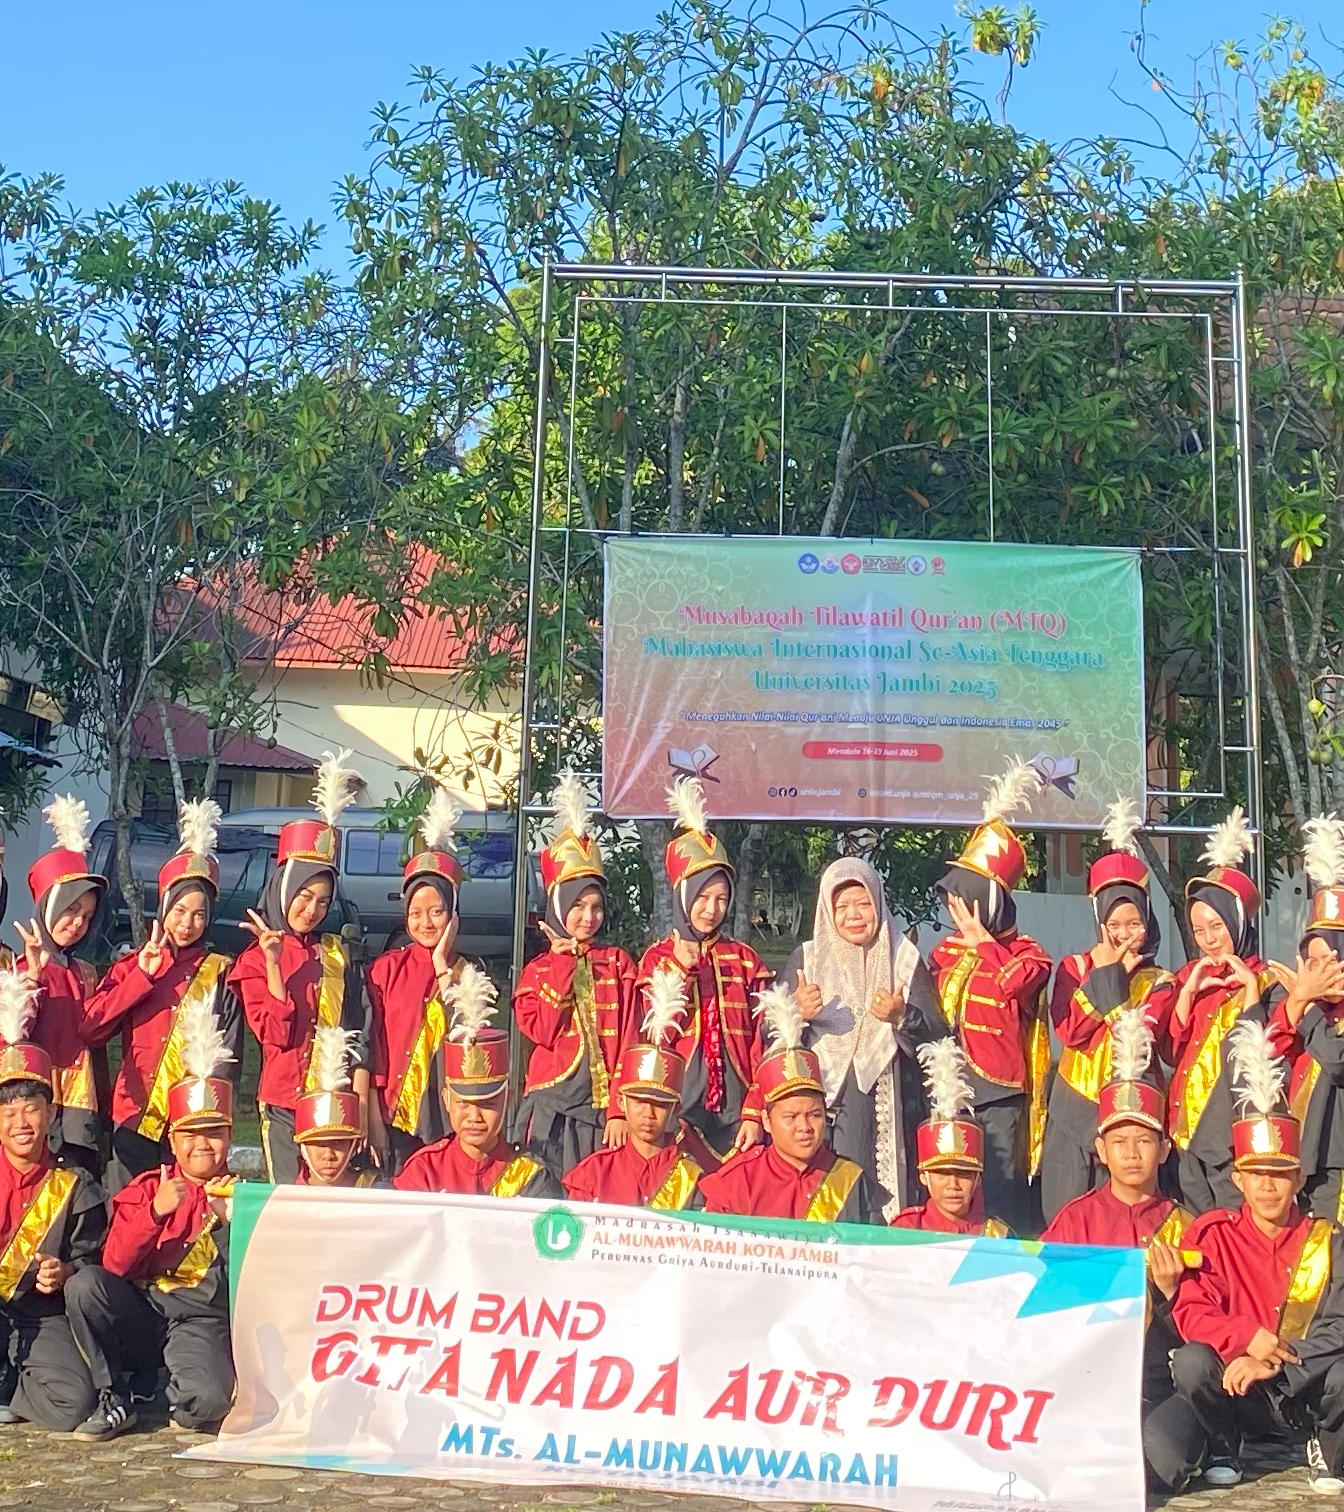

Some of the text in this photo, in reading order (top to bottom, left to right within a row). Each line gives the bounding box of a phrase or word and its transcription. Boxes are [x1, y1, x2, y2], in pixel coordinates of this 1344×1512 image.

[680, 603, 1067, 638] Musabaqah Tilawatil Qur'an (MTQ)
[644, 636, 1105, 670] Mahasiswa Internasional Se-Asia Tenggara
[750, 670, 999, 700] Universitas Jambi 2025
[960, 716, 1007, 727] Indonesia
[593, 1231, 839, 1265] AL-MUNAWWARAH KOTA JAMBI
[315, 1284, 607, 1341] DRUM BAND
[485, 1347, 680, 1417] NADA
[703, 1361, 851, 1437] AUR
[866, 1376, 1055, 1451] DURI
[440, 1422, 899, 1488] MTs. AL-MUNAWWARAH
